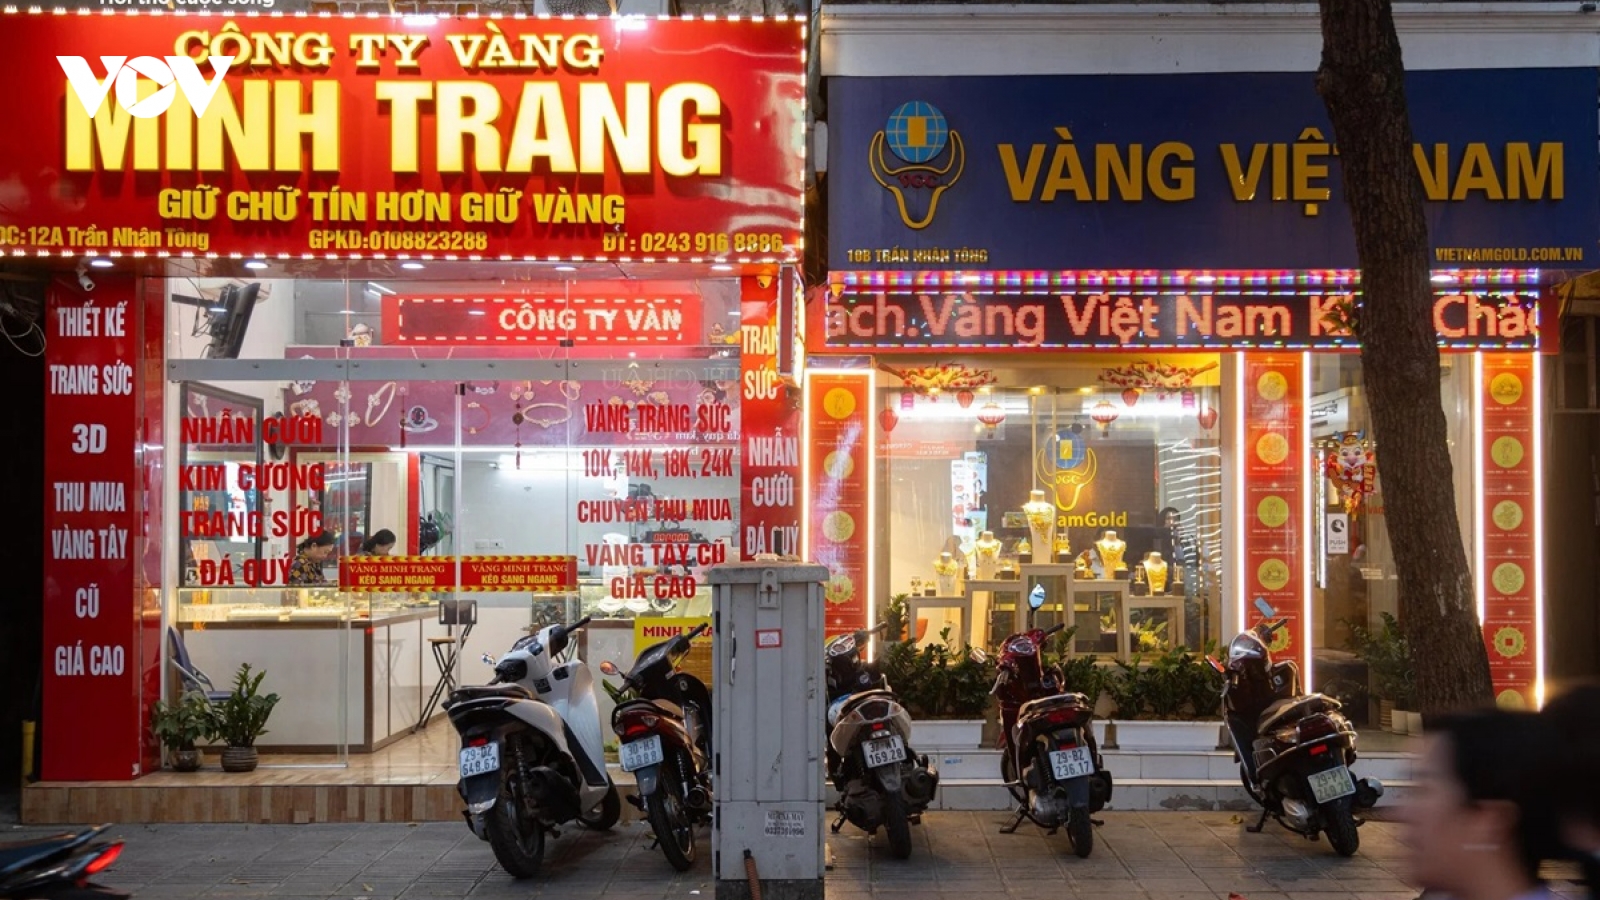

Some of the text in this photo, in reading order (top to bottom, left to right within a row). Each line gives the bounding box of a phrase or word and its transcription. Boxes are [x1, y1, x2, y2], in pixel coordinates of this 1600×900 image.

[174, 21, 603, 70] CÔNG TY VÀNG
[66, 79, 721, 176] MINH TRANG
[997, 127, 1195, 202] VÀNG
[1219, 127, 1342, 215] VIỆ
[159, 185, 625, 225] GIỮ CHỮ TÍN HƠN GIỮ VÀNG
[67, 224, 108, 247] Trần
[113, 226, 161, 247] Nhân
[165, 228, 208, 250] Tông
[309, 230, 488, 250] GPKD:0108823288
[641, 232, 690, 252] 0243
[695, 232, 729, 252] 916
[954, 247, 988, 263] TÔNG
[1435, 247, 1583, 262] VIETNAMGOLD.COM.VN
[57, 300, 128, 336] THIẾT KẾ
[499, 303, 576, 331] CÔNG
[584, 309, 618, 331] TY
[1061, 293, 1160, 344] Việt
[1176, 295, 1292, 337] Nam
[49, 359, 132, 395] TRANG SỨC
[743, 363, 777, 400] SỨC
[181, 407, 322, 444] NHẪN CƯỚI
[584, 399, 731, 433] VÀNG TRANG SỨC
[72, 424, 107, 454] 3D
[749, 427, 798, 467] NHẪN
[179, 462, 324, 491] KIM CƯƠNG
[582, 449, 733, 480] 10K, 14K, 18K, 24K
[54, 482, 125, 512] THU MUA
[752, 471, 794, 507] CƯỚI
[179, 504, 323, 538] TRANG SỨC
[654, 499, 687, 523] THU
[693, 498, 732, 521] MUA
[52, 524, 128, 559] VÀNG TÂY
[585, 539, 643, 567] VÀNG
[697, 539, 726, 566] CŨ
[199, 553, 293, 588] ĐÁ QUÝ
[359, 573, 435, 585] KÉO SANG NGANG
[380, 565, 408, 573] MINH
[410, 565, 445, 573] TRANG
[481, 573, 557, 584] KÉO SANG NGANG
[503, 564, 530, 572] MINH
[533, 564, 567, 573] TRANG
[75, 583, 100, 619] CŨ
[611, 572, 696, 600] GIÁ CAO
[643, 627, 682, 637] MINH
[55, 640, 125, 676] GIÁ CAO
[868, 748, 903, 765] 169.28
[1056, 761, 1089, 777] 236.17
